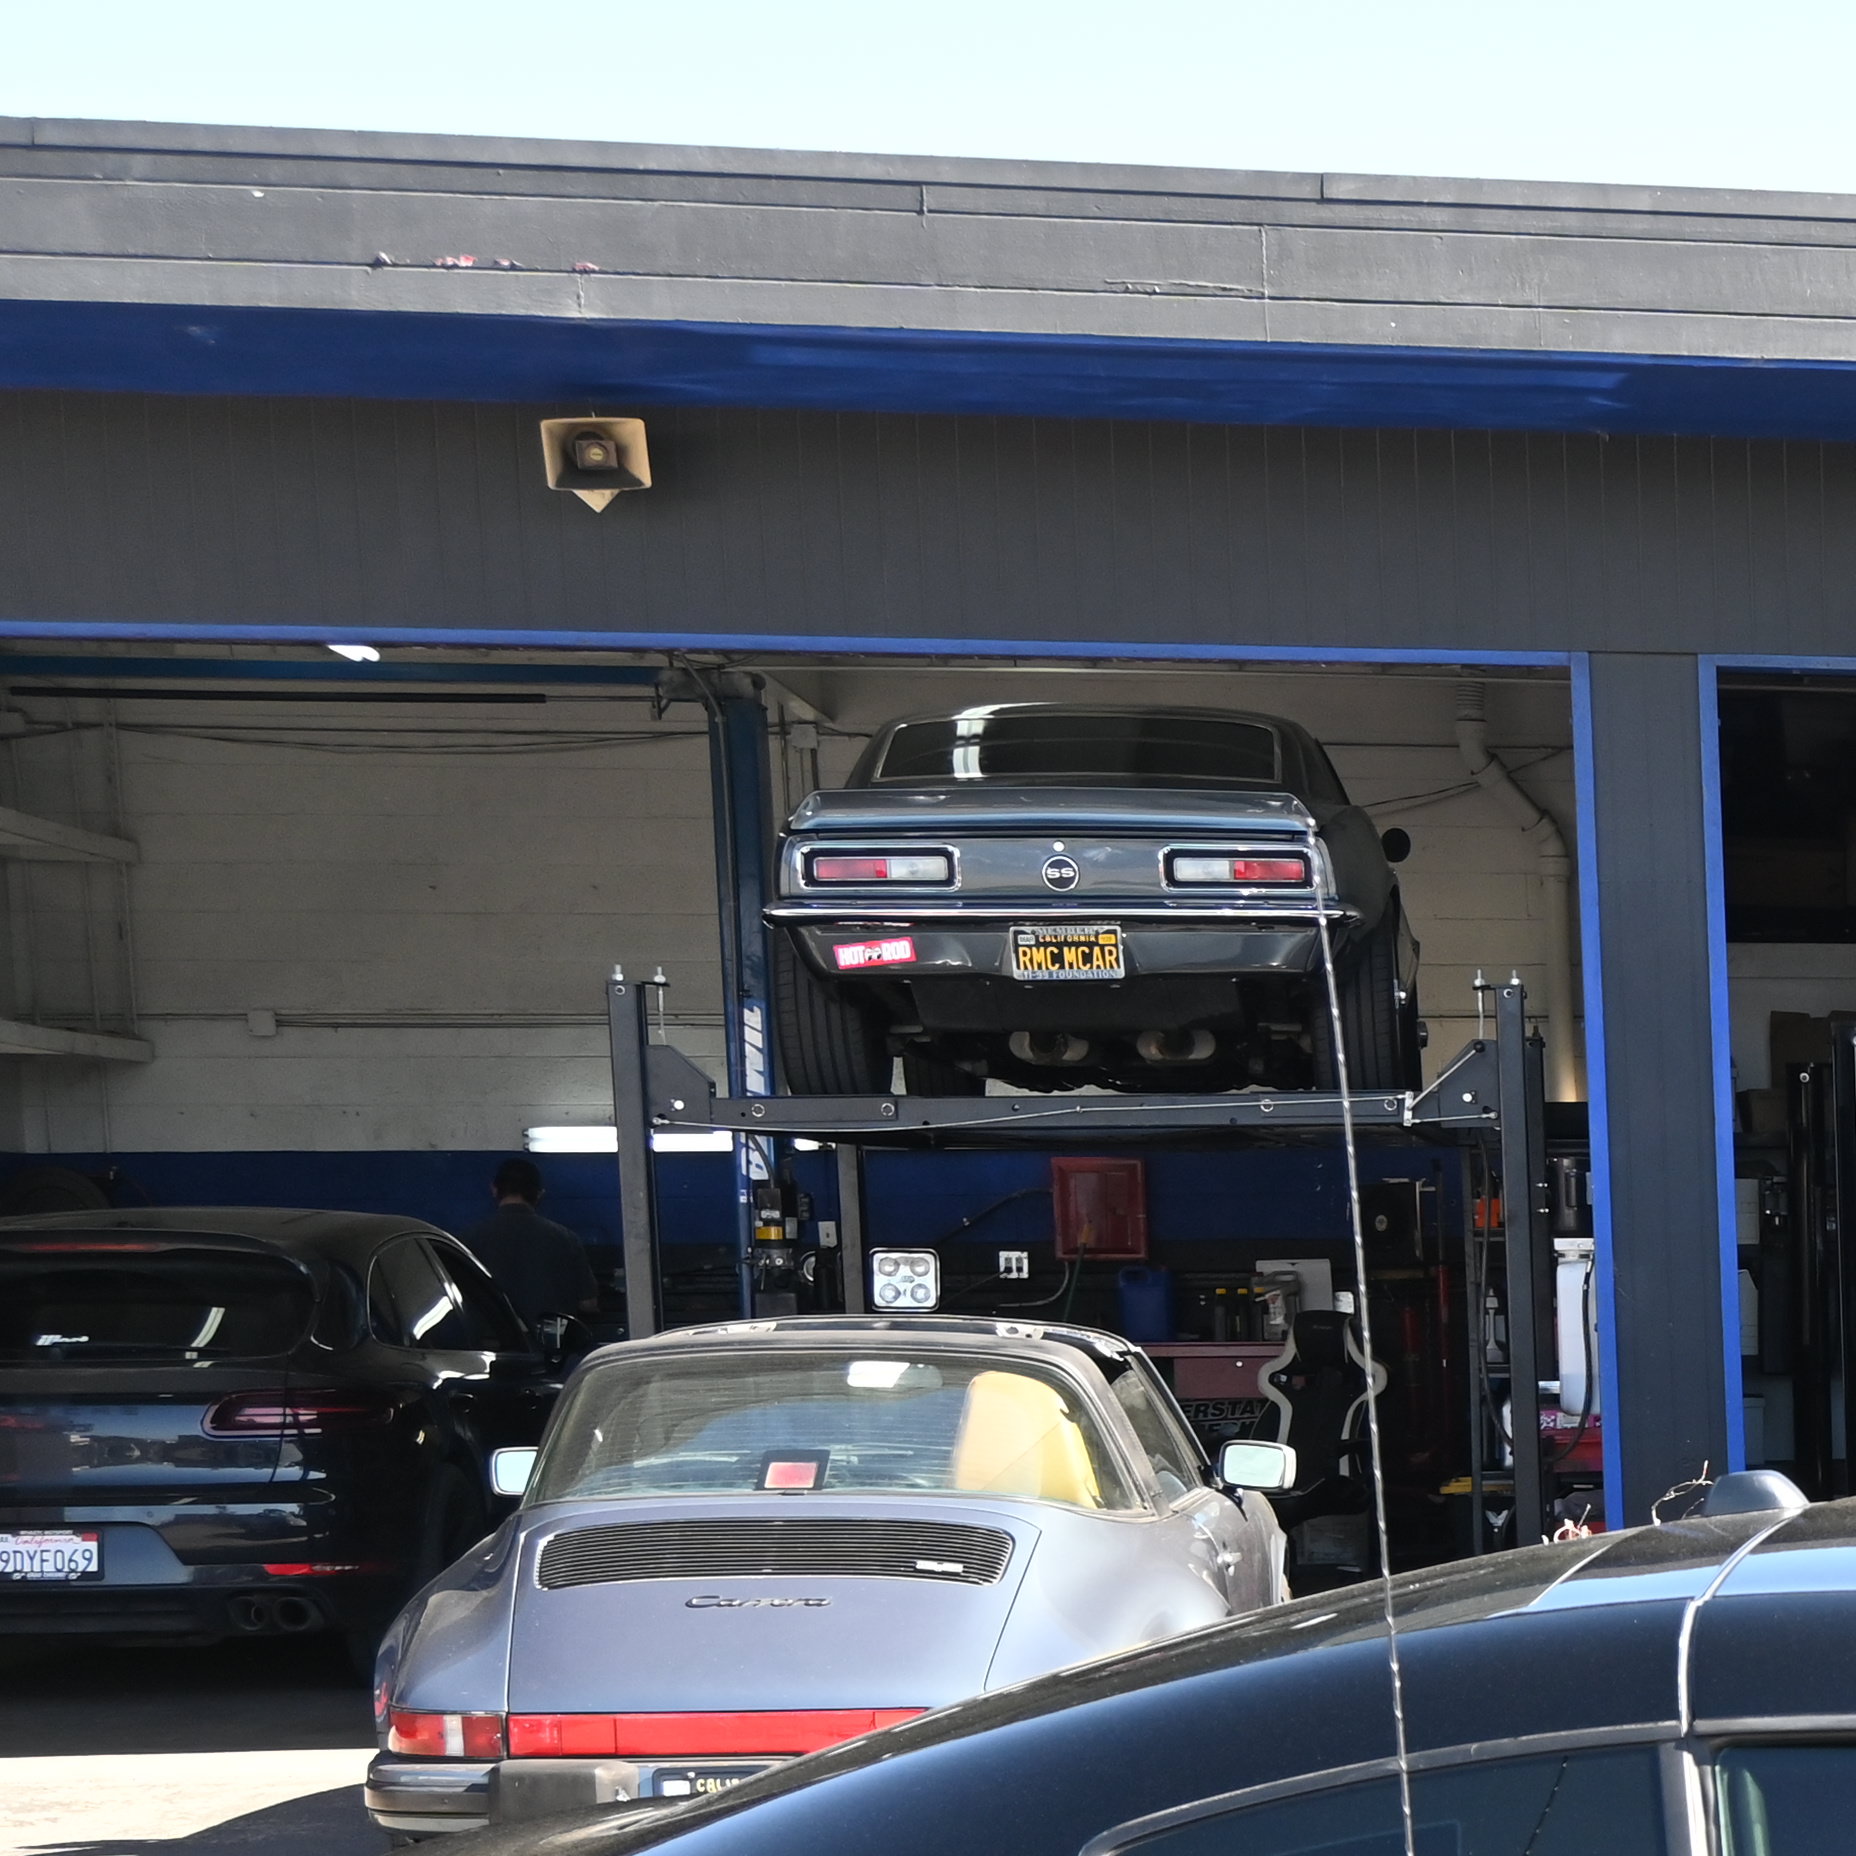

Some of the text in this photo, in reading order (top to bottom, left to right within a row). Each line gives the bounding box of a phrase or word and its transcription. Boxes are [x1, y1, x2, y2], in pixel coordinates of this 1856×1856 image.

[1046, 867, 1075, 879] SS
[838, 940, 911, 967] HOT ROD
[1018, 946, 1118, 970] RMC MCAR
[0, 1549, 94, 1572] 9DYF069
[684, 1595, 832, 1609] Carrera
